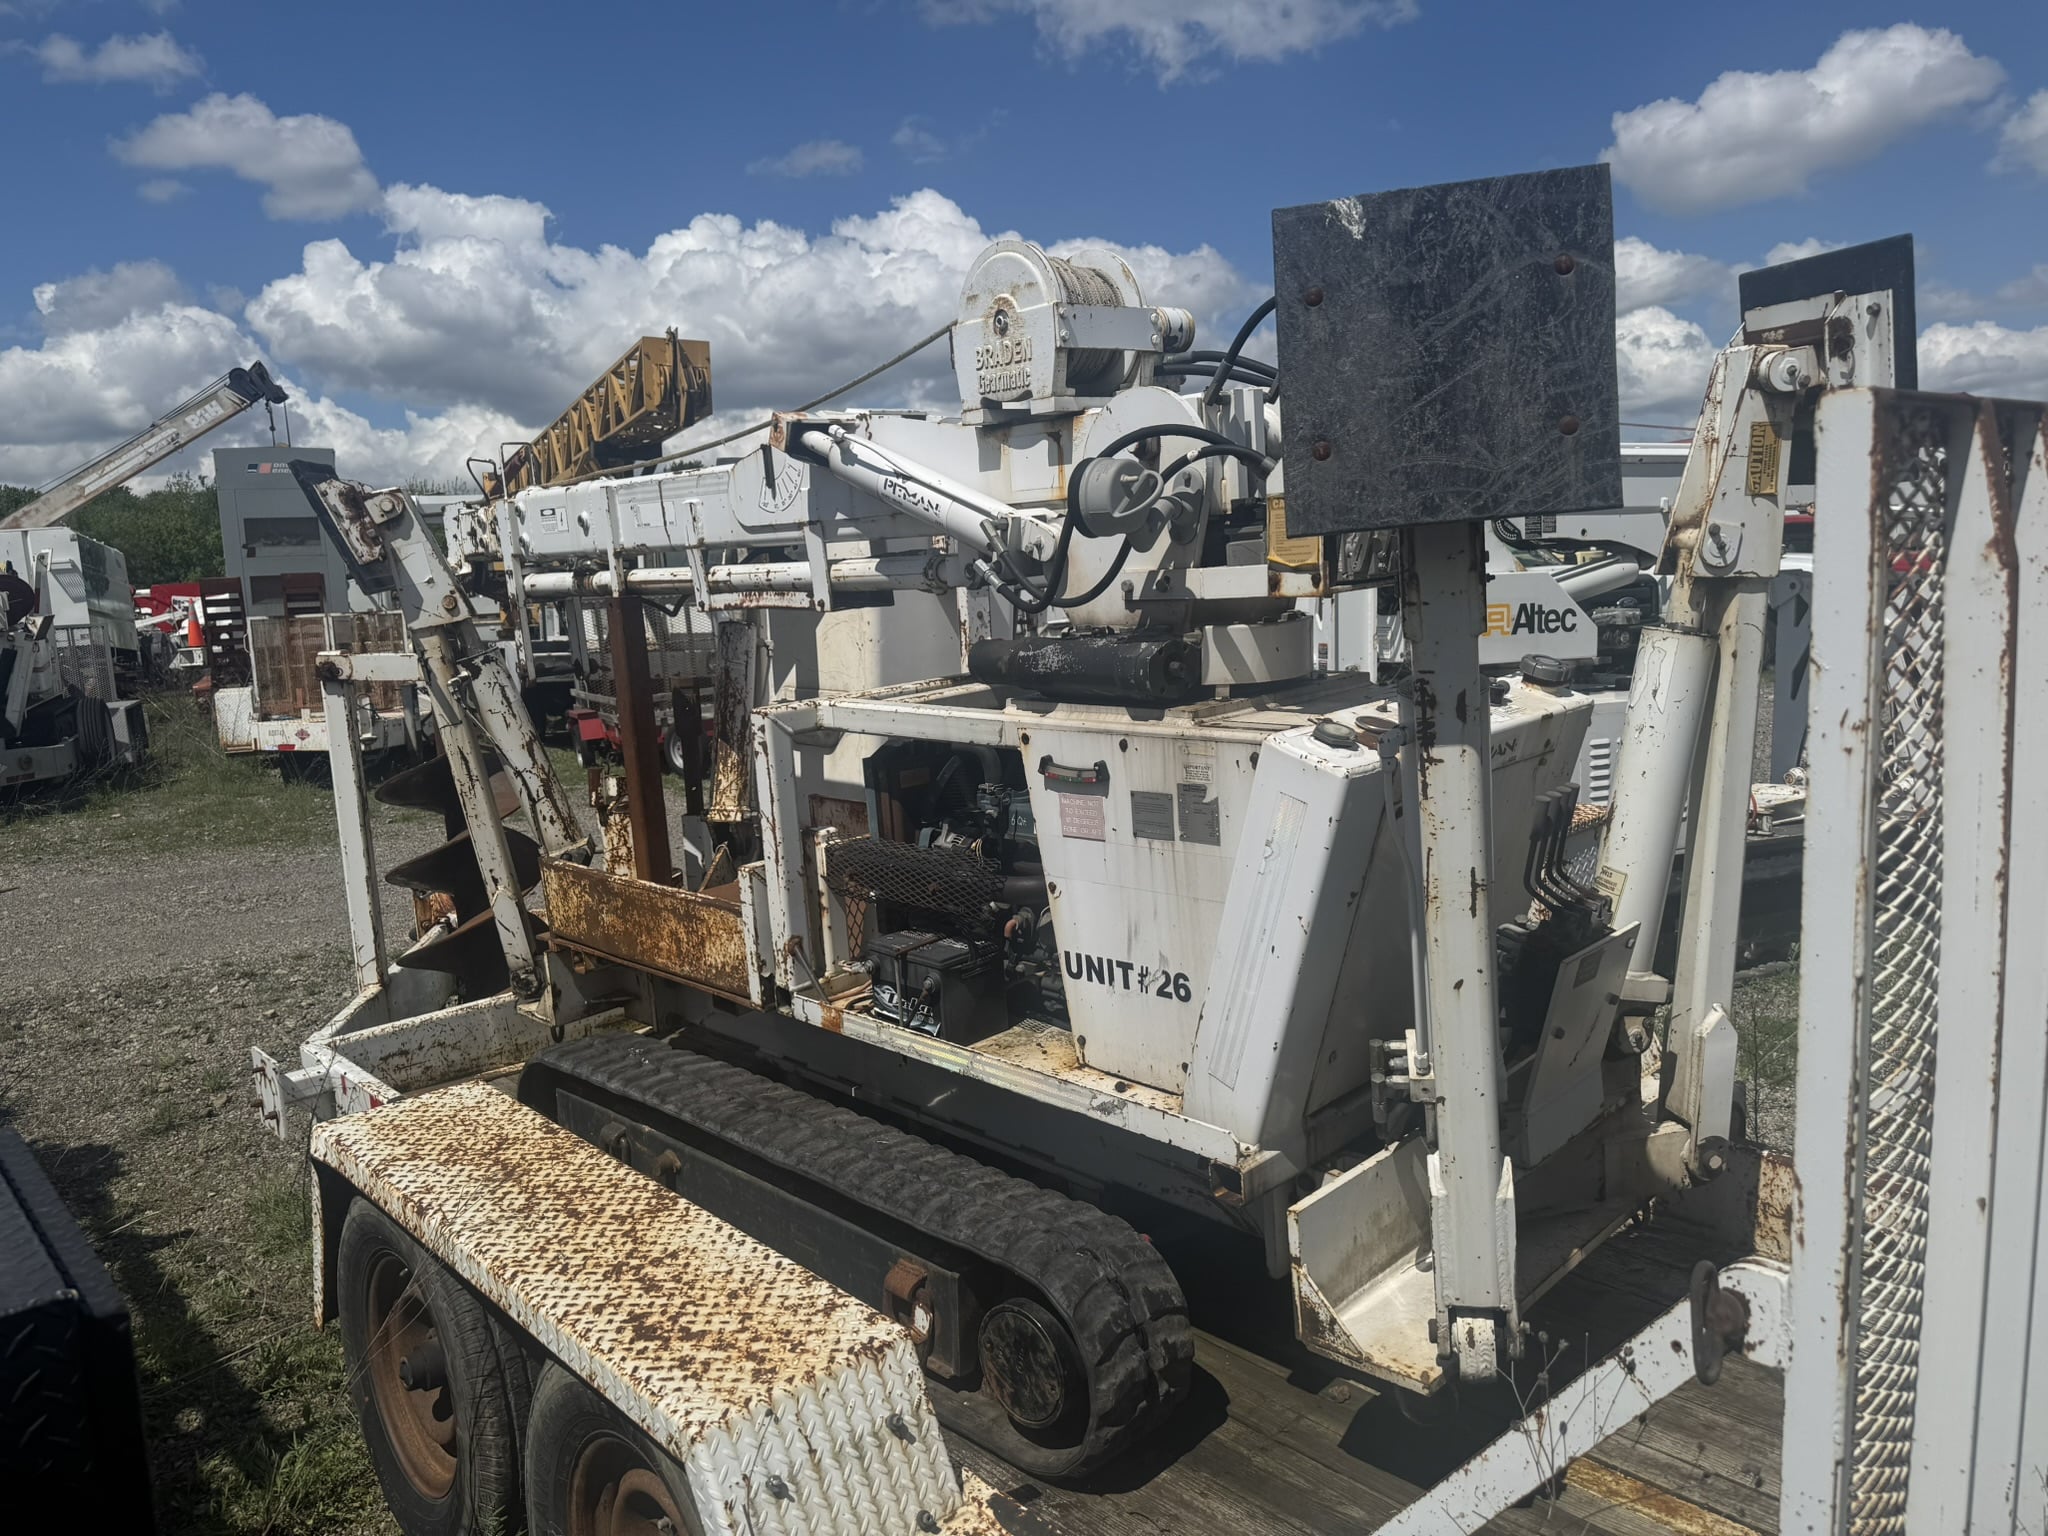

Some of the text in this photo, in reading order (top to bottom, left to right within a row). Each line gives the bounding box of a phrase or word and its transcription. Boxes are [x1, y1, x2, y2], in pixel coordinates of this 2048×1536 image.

[976, 336, 1032, 371] BRADEN
[978, 364, 1031, 396] Gearmatic
[1511, 603, 1577, 635] Altec
[1064, 949, 1134, 991] UNIT
